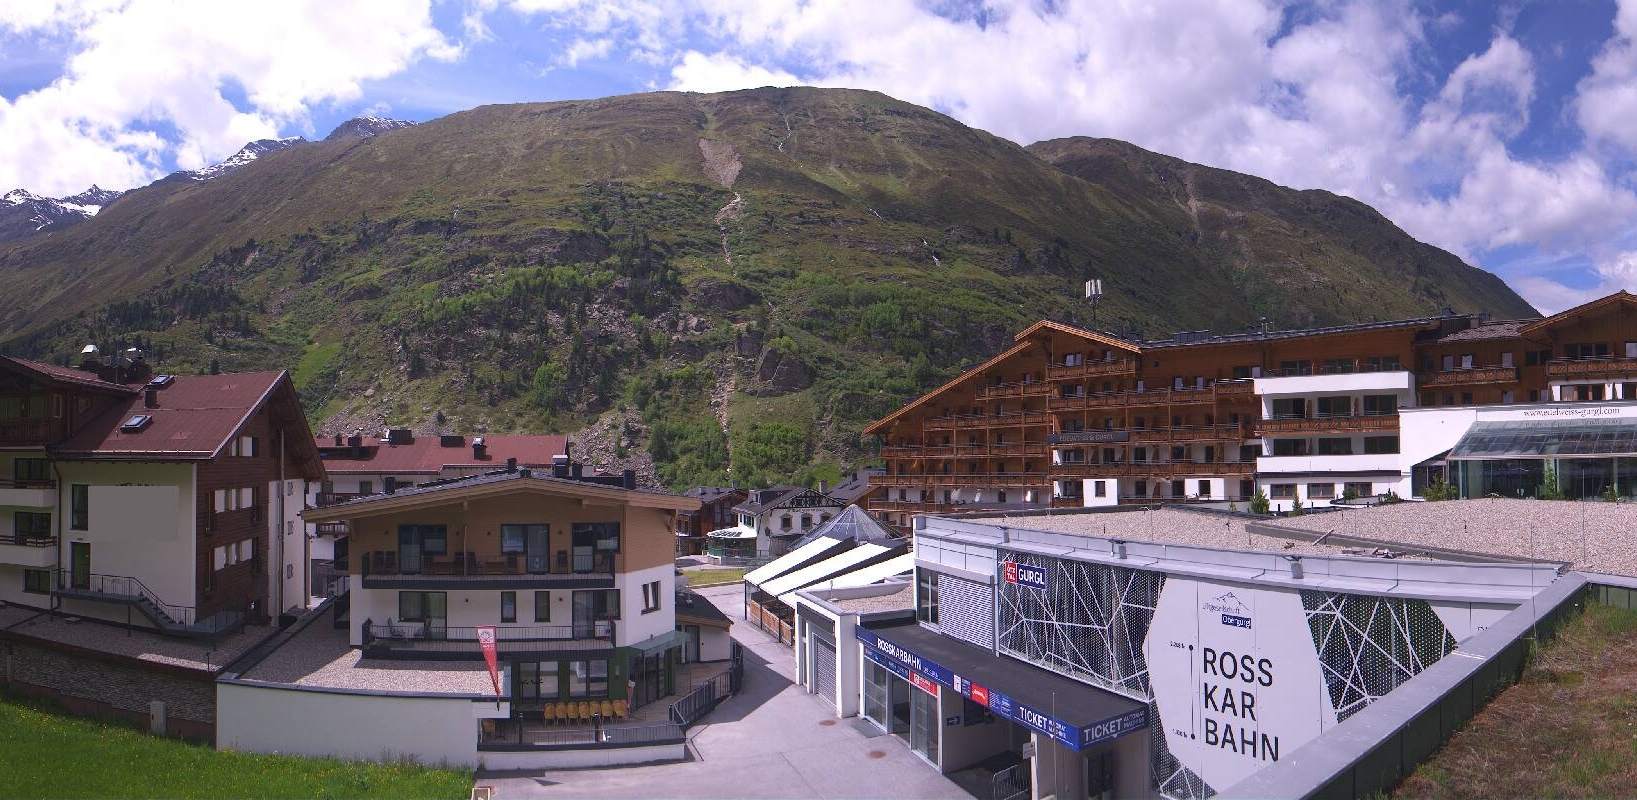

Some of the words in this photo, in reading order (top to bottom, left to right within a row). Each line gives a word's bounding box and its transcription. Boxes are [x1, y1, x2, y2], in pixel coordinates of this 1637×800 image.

[1018, 568, 1045, 585] GURGL
[877, 638, 922, 670] ROSSKARBAHN
[1203, 647, 1273, 687] ROSS
[1019, 706, 1048, 730] TICKET
[1204, 683, 1257, 721] KAR
[1083, 717, 1123, 742] TICKET
[1205, 718, 1279, 762] BAHN
